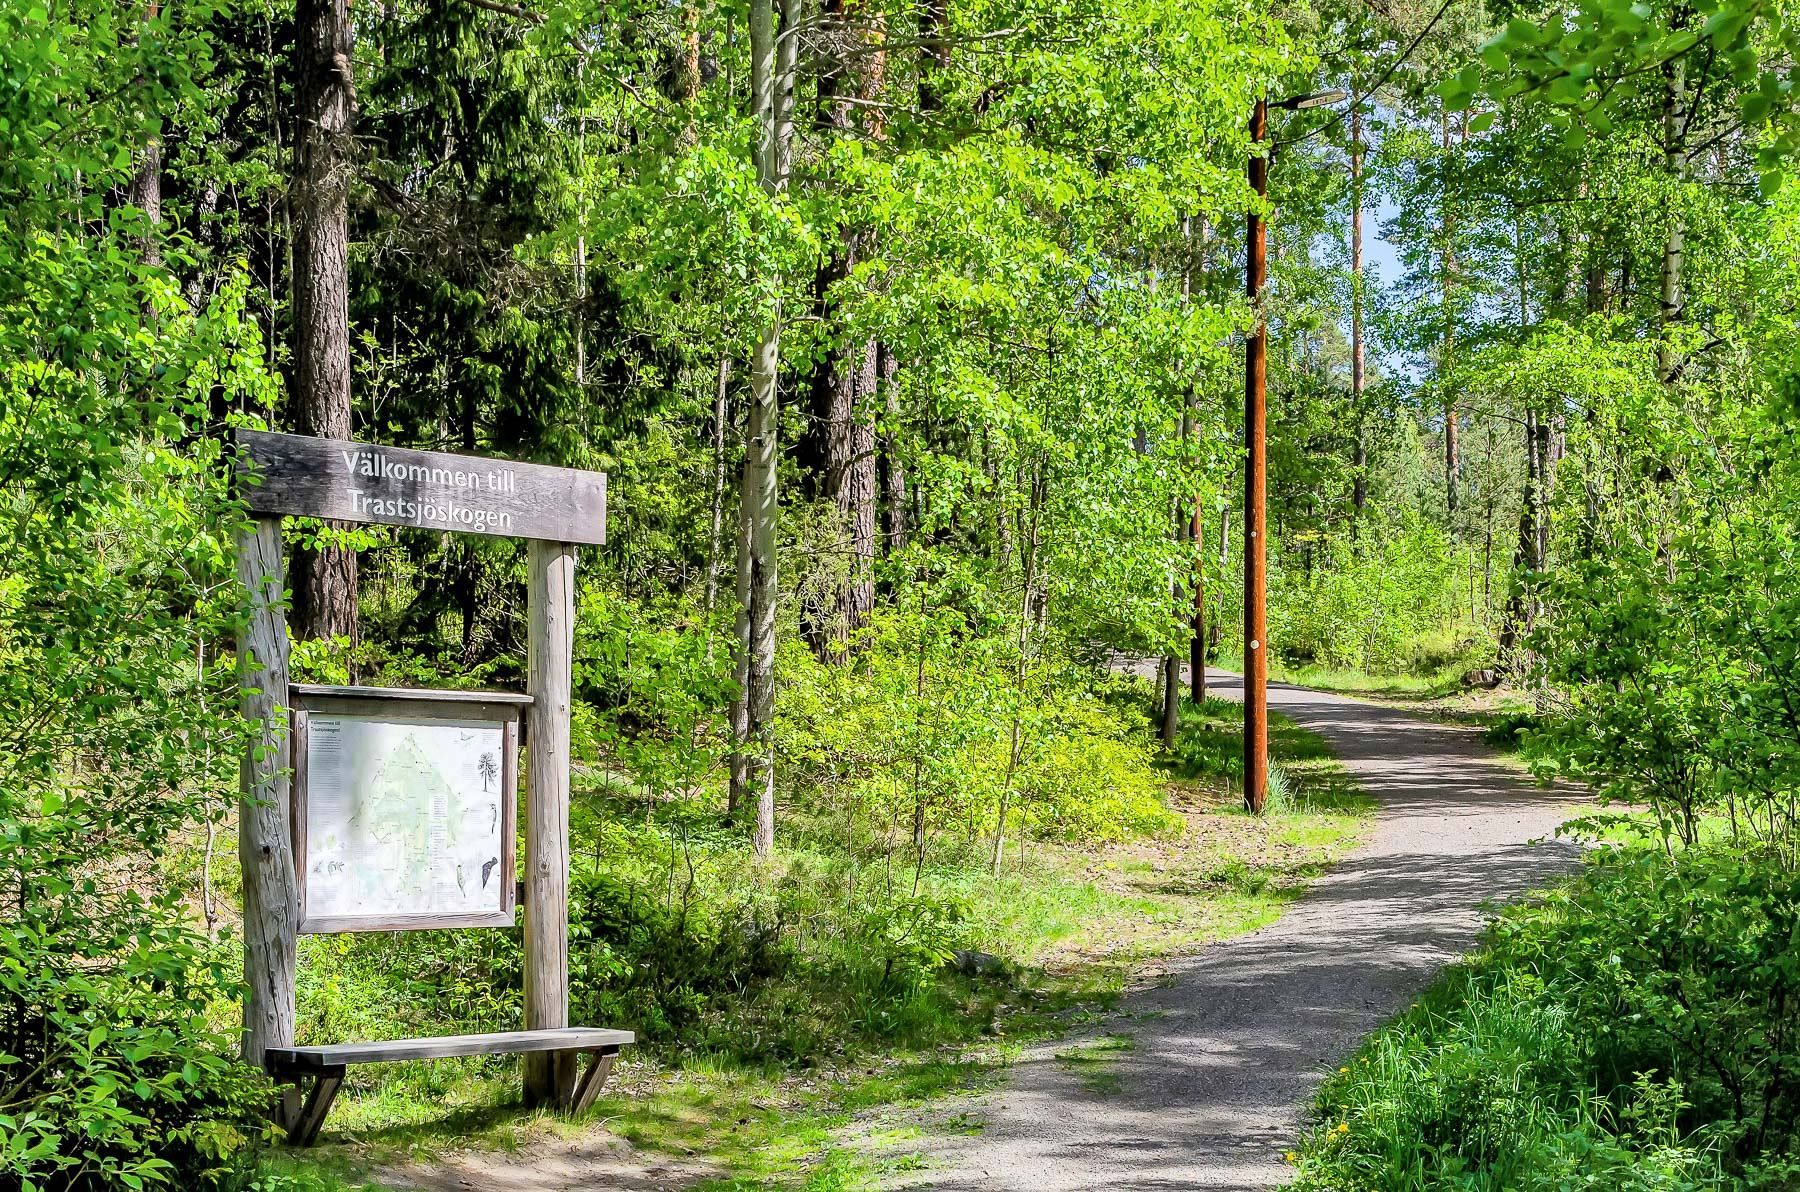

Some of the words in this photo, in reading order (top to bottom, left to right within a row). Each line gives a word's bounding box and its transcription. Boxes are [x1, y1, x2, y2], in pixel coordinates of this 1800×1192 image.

[342, 450, 480, 488] Välkommen
[488, 468, 515, 493] till
[347, 488, 512, 532] Trastsjöskogen
